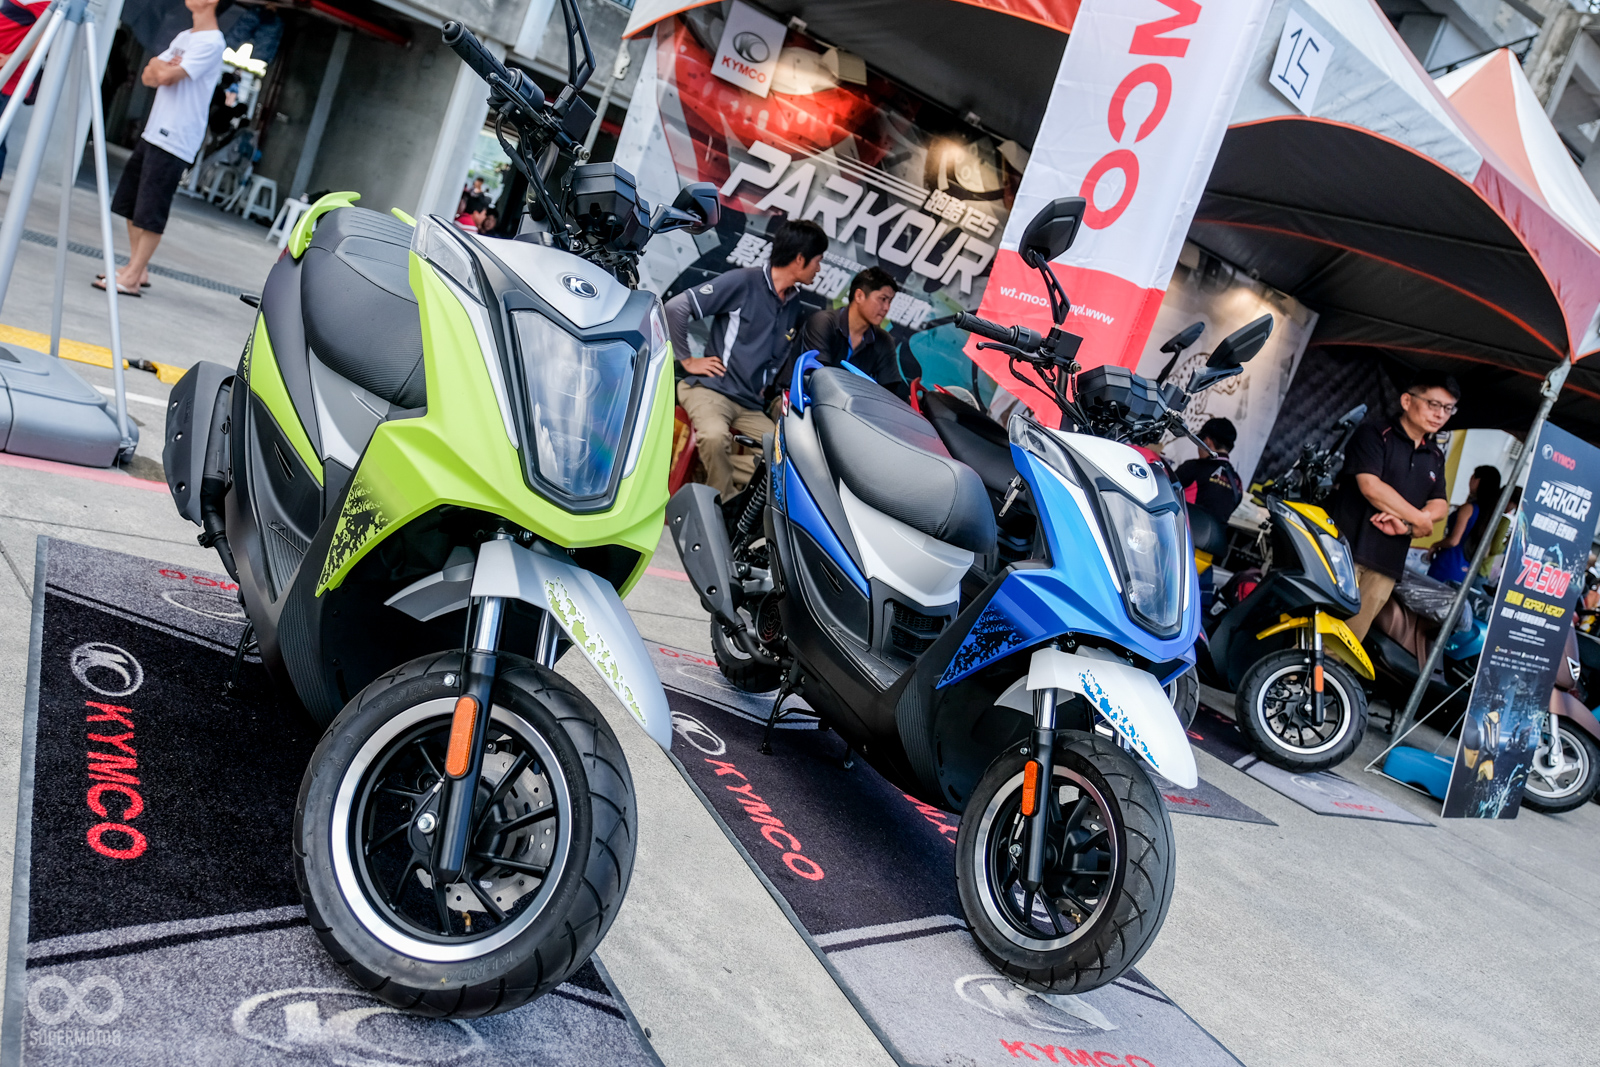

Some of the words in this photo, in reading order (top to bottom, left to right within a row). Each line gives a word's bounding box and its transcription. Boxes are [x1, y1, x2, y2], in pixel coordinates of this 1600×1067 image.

[721, 55, 767, 84] KYMCO
[1278, 28, 1320, 100] 15
[719, 140, 996, 295] PARKOUR
[1552, 451, 1576, 471] KYMCO
[1535, 480, 1592, 522] PARKOUR
[85, 700, 148, 859] KYMCO
[704, 758, 825, 881] KYMCO
[999, 1038, 1157, 1067] KYMCO
